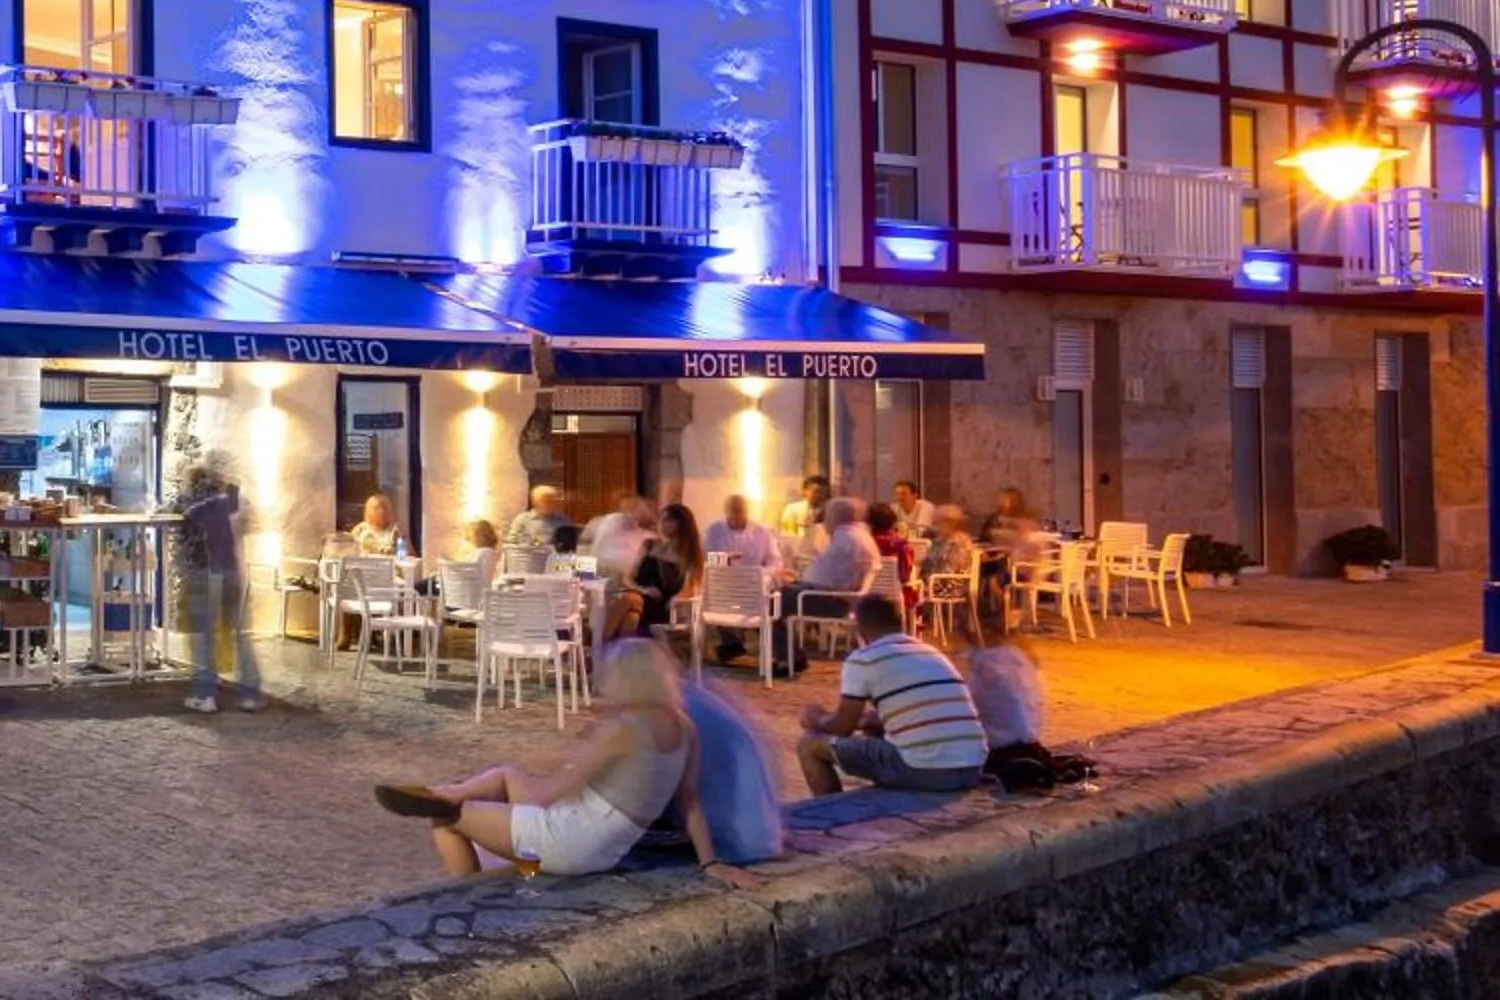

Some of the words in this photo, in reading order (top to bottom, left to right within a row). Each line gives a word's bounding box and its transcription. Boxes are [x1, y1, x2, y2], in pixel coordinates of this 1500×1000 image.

[118, 331, 213, 360] HOTEL
[233, 335, 267, 361] EL
[285, 337, 389, 365] PUERTO
[684, 353, 746, 377] HOTEL
[765, 354, 788, 376] EL
[802, 354, 878, 377] PUERTO
